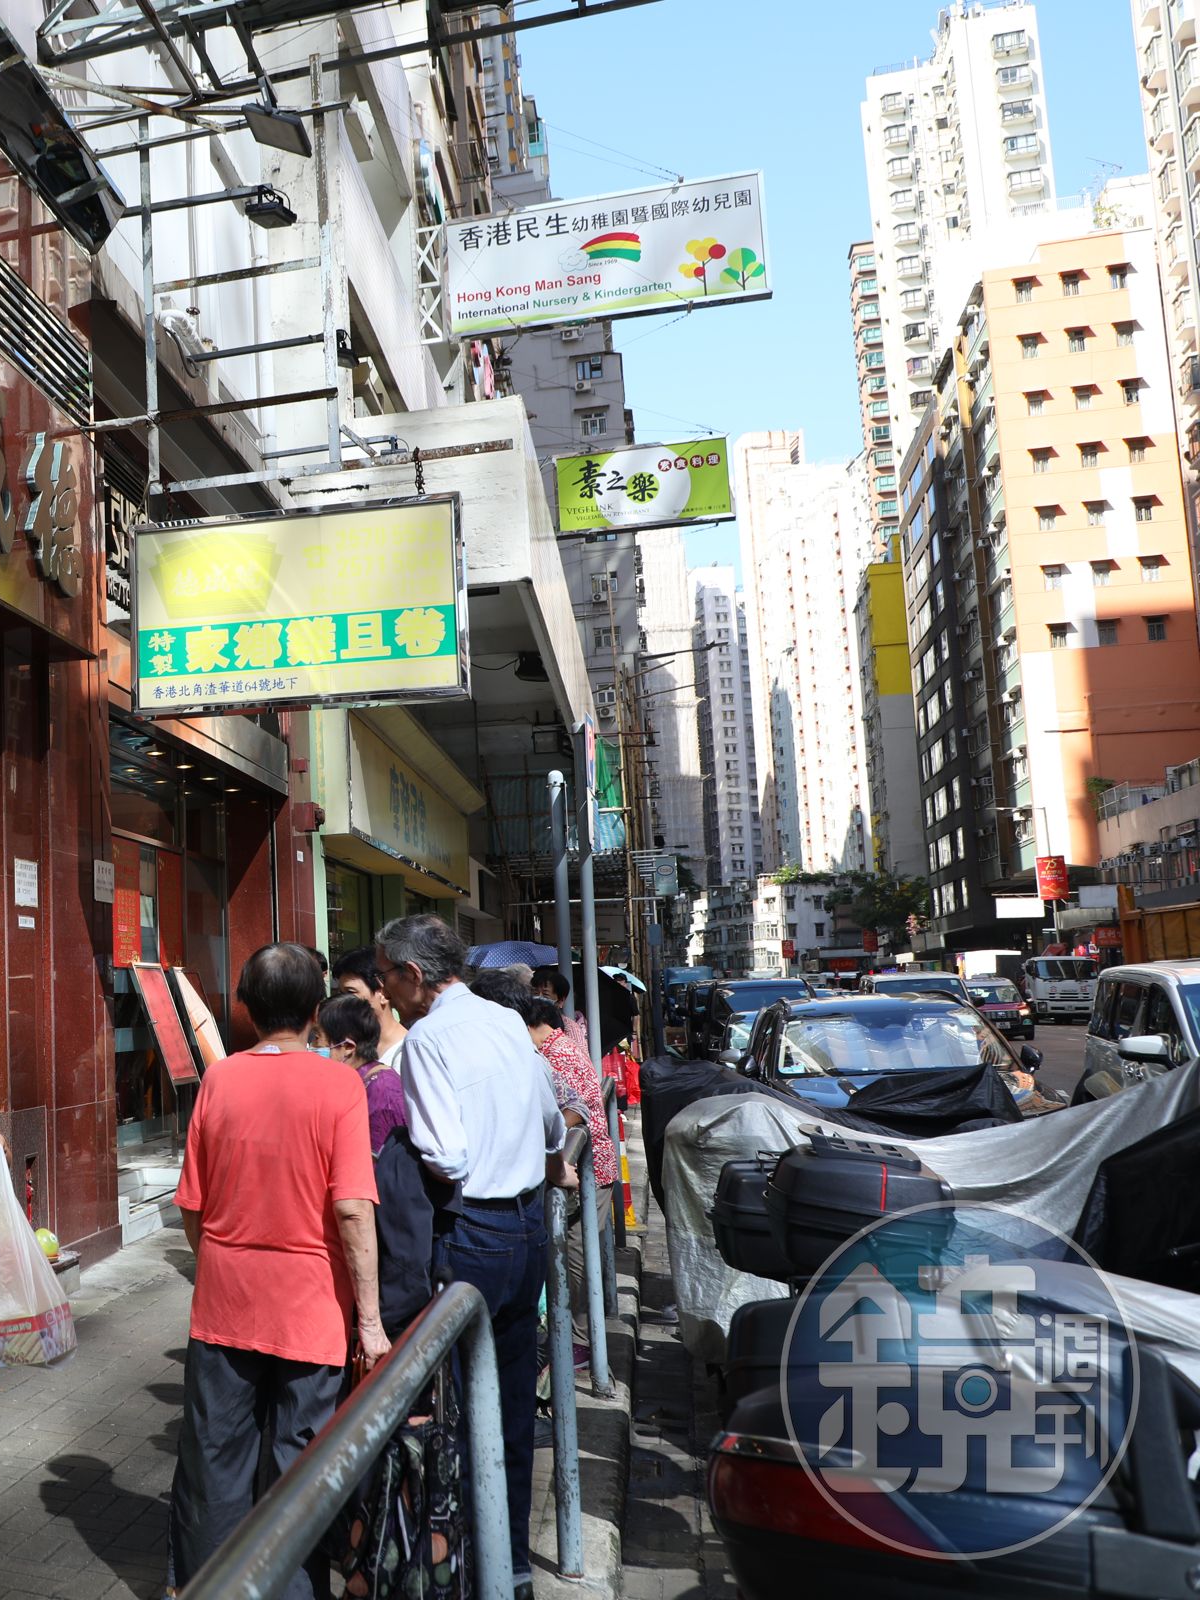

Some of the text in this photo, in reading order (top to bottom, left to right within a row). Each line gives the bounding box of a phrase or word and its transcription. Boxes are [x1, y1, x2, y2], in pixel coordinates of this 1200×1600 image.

[457, 272, 602, 304] Hong Kong Man Sang
[458, 280, 672, 320] International Nursery & Kindergarten
[572, 460, 659, 502] 素之樂
[567, 503, 614, 515] VEGELINK
